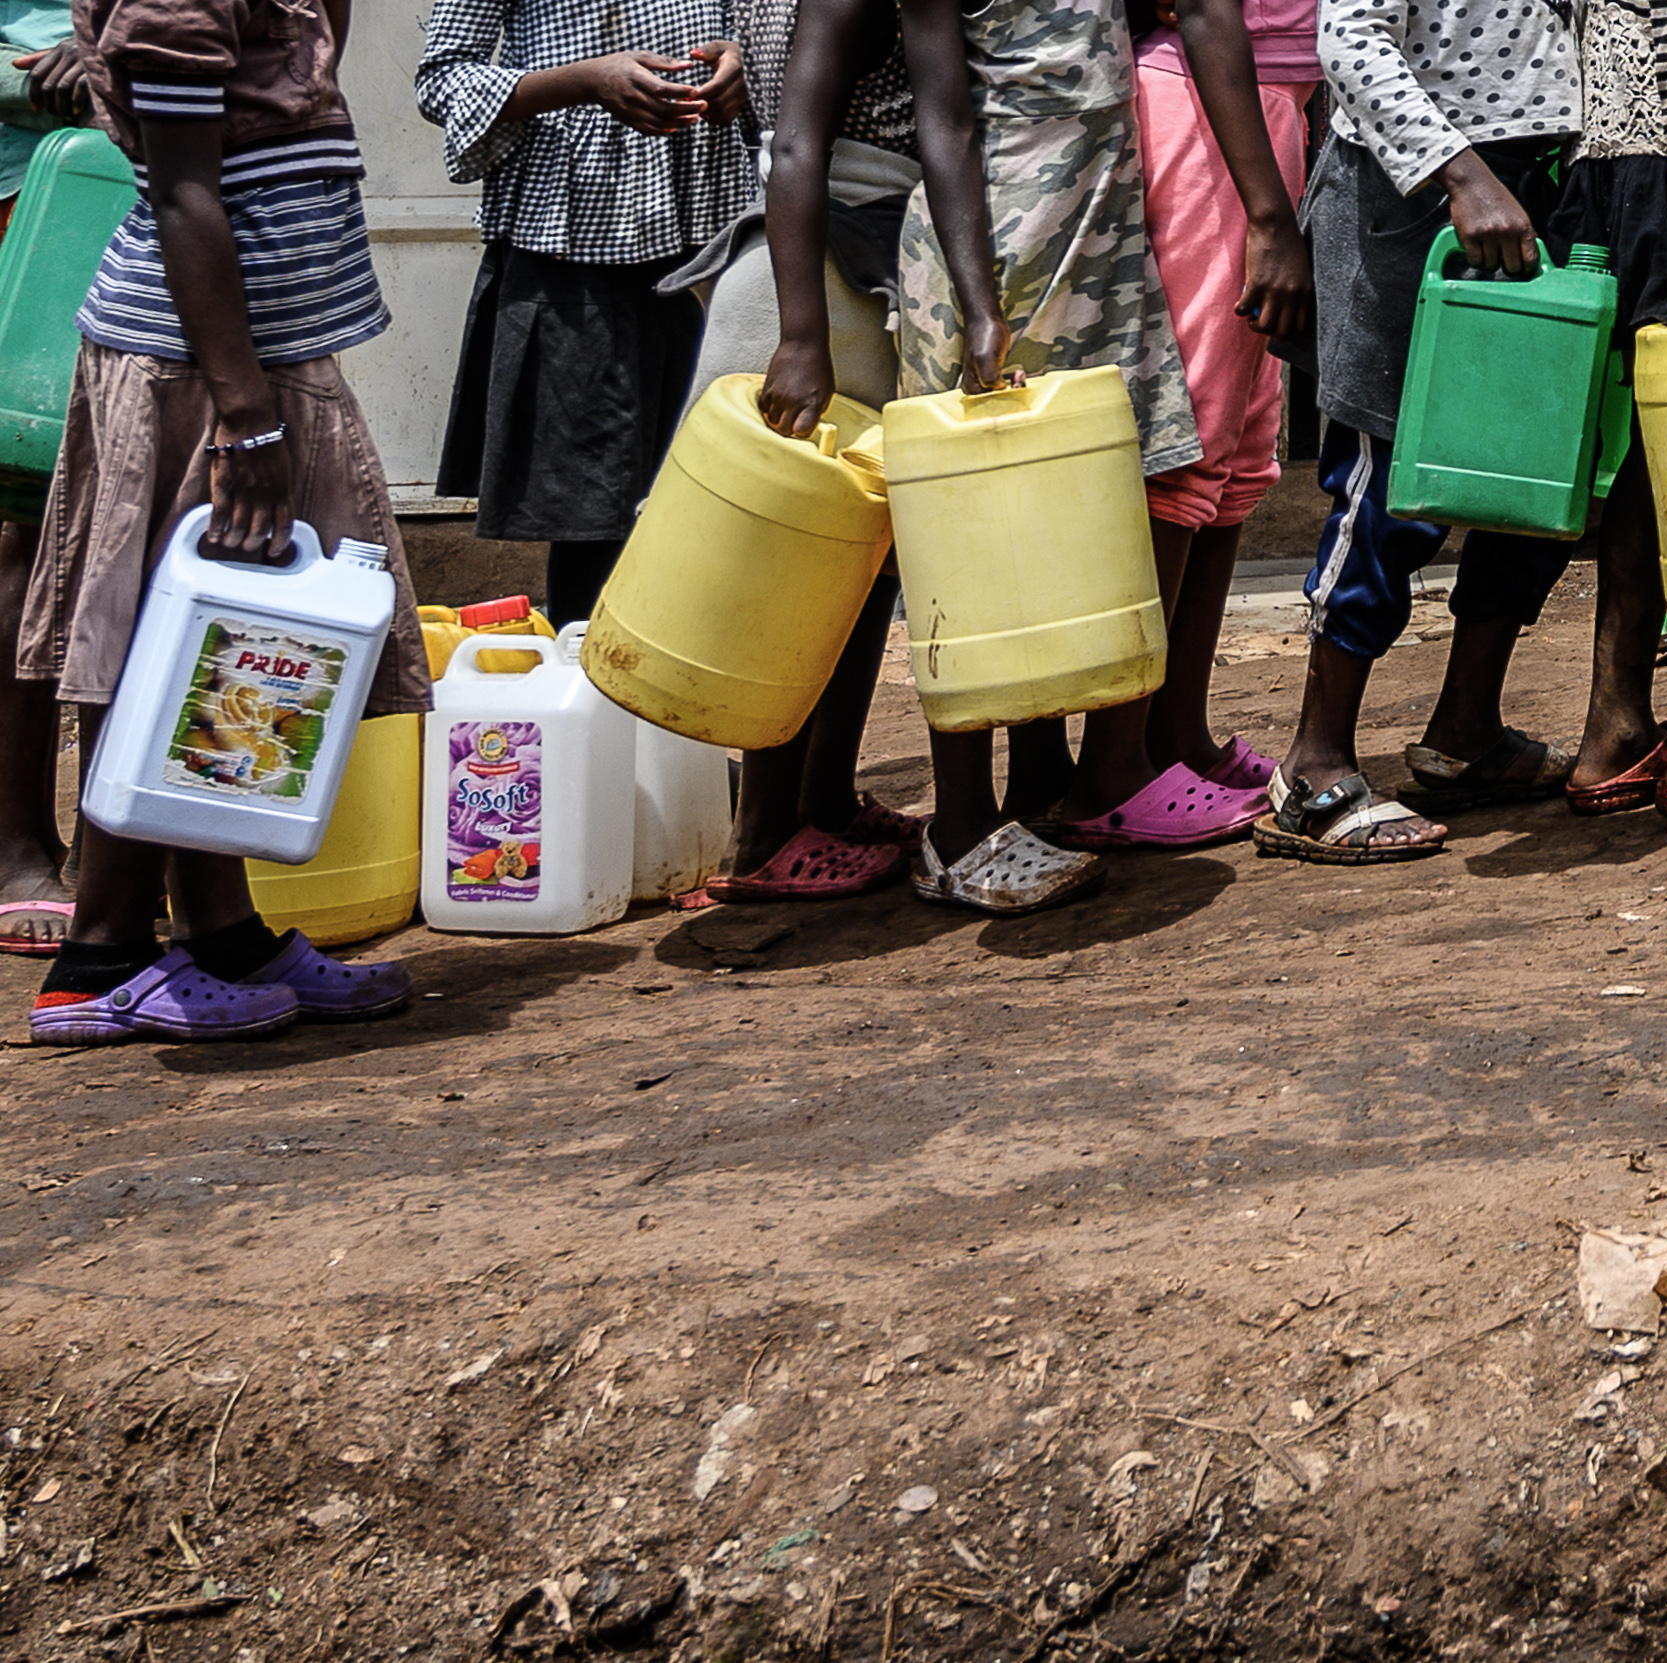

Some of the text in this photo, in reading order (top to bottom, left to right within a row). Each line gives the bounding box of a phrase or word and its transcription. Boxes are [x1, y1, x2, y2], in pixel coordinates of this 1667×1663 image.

[234, 650, 312, 680] PRIDE
[457, 777, 530, 814] SoSoft
[474, 820, 512, 834] Luxury
